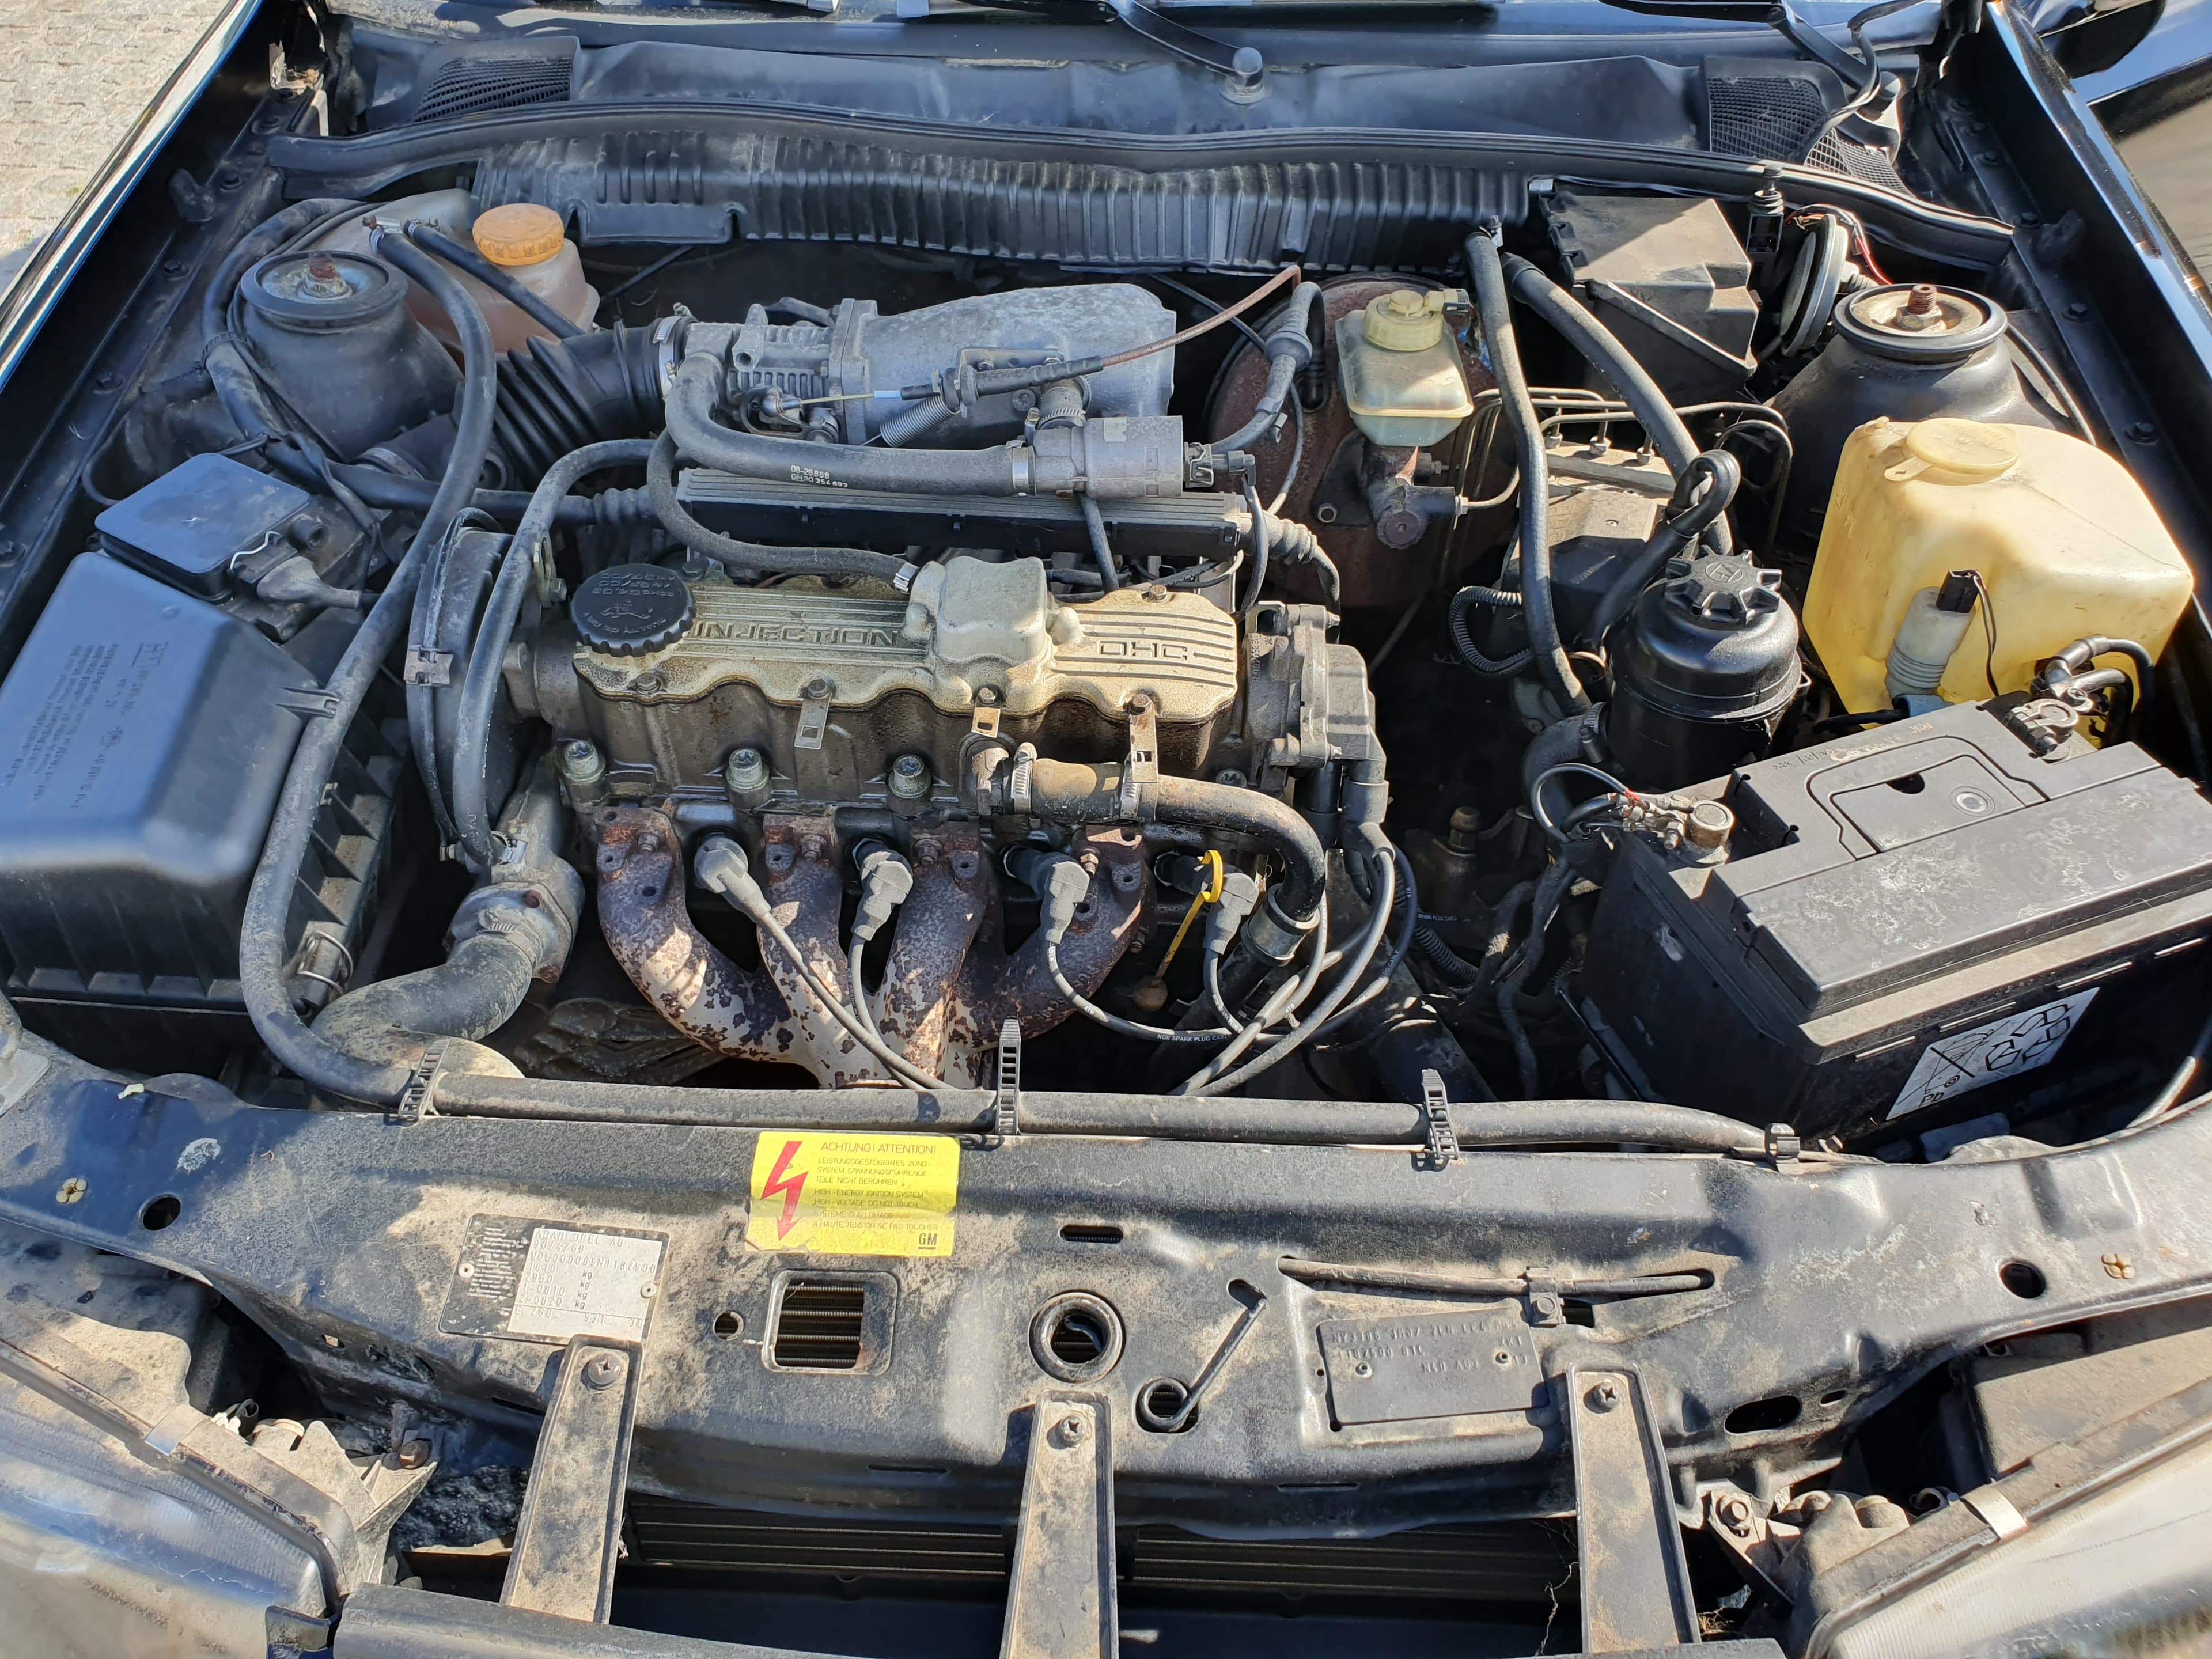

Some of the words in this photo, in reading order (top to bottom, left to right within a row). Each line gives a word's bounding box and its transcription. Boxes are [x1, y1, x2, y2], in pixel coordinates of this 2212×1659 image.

[694, 620, 899, 646] INJECTION
[1097, 640, 1188, 661] OHC
[1157, 1033, 1171, 1041] NGK
[1918, 1091, 1945, 1107] Pb
[820, 1142, 875, 1153] ACHTUNG!
[877, 1143, 936, 1154] ATTENTION!
[836, 1176, 857, 1184] NICHT
[836, 1188, 864, 1196] ENERGY
[866, 1190, 894, 1198] IGNITION
[896, 1191, 924, 1199] SYSTEM
[836, 1199, 865, 1207] VOLTAGE
[820, 1220, 846, 1228] HAUTE
[847, 1221, 876, 1229] TENSION
[877, 1222, 887, 1230] NE
[906, 1223, 938, 1232] TOUCHER
[573, 1232, 601, 1245] OPEL
[918, 1232, 938, 1245] GM
[582, 1270, 593, 1279] kg
[579, 1279, 590, 1289] kg
[577, 1290, 588, 1300] kg
[574, 1300, 586, 1310] kg
